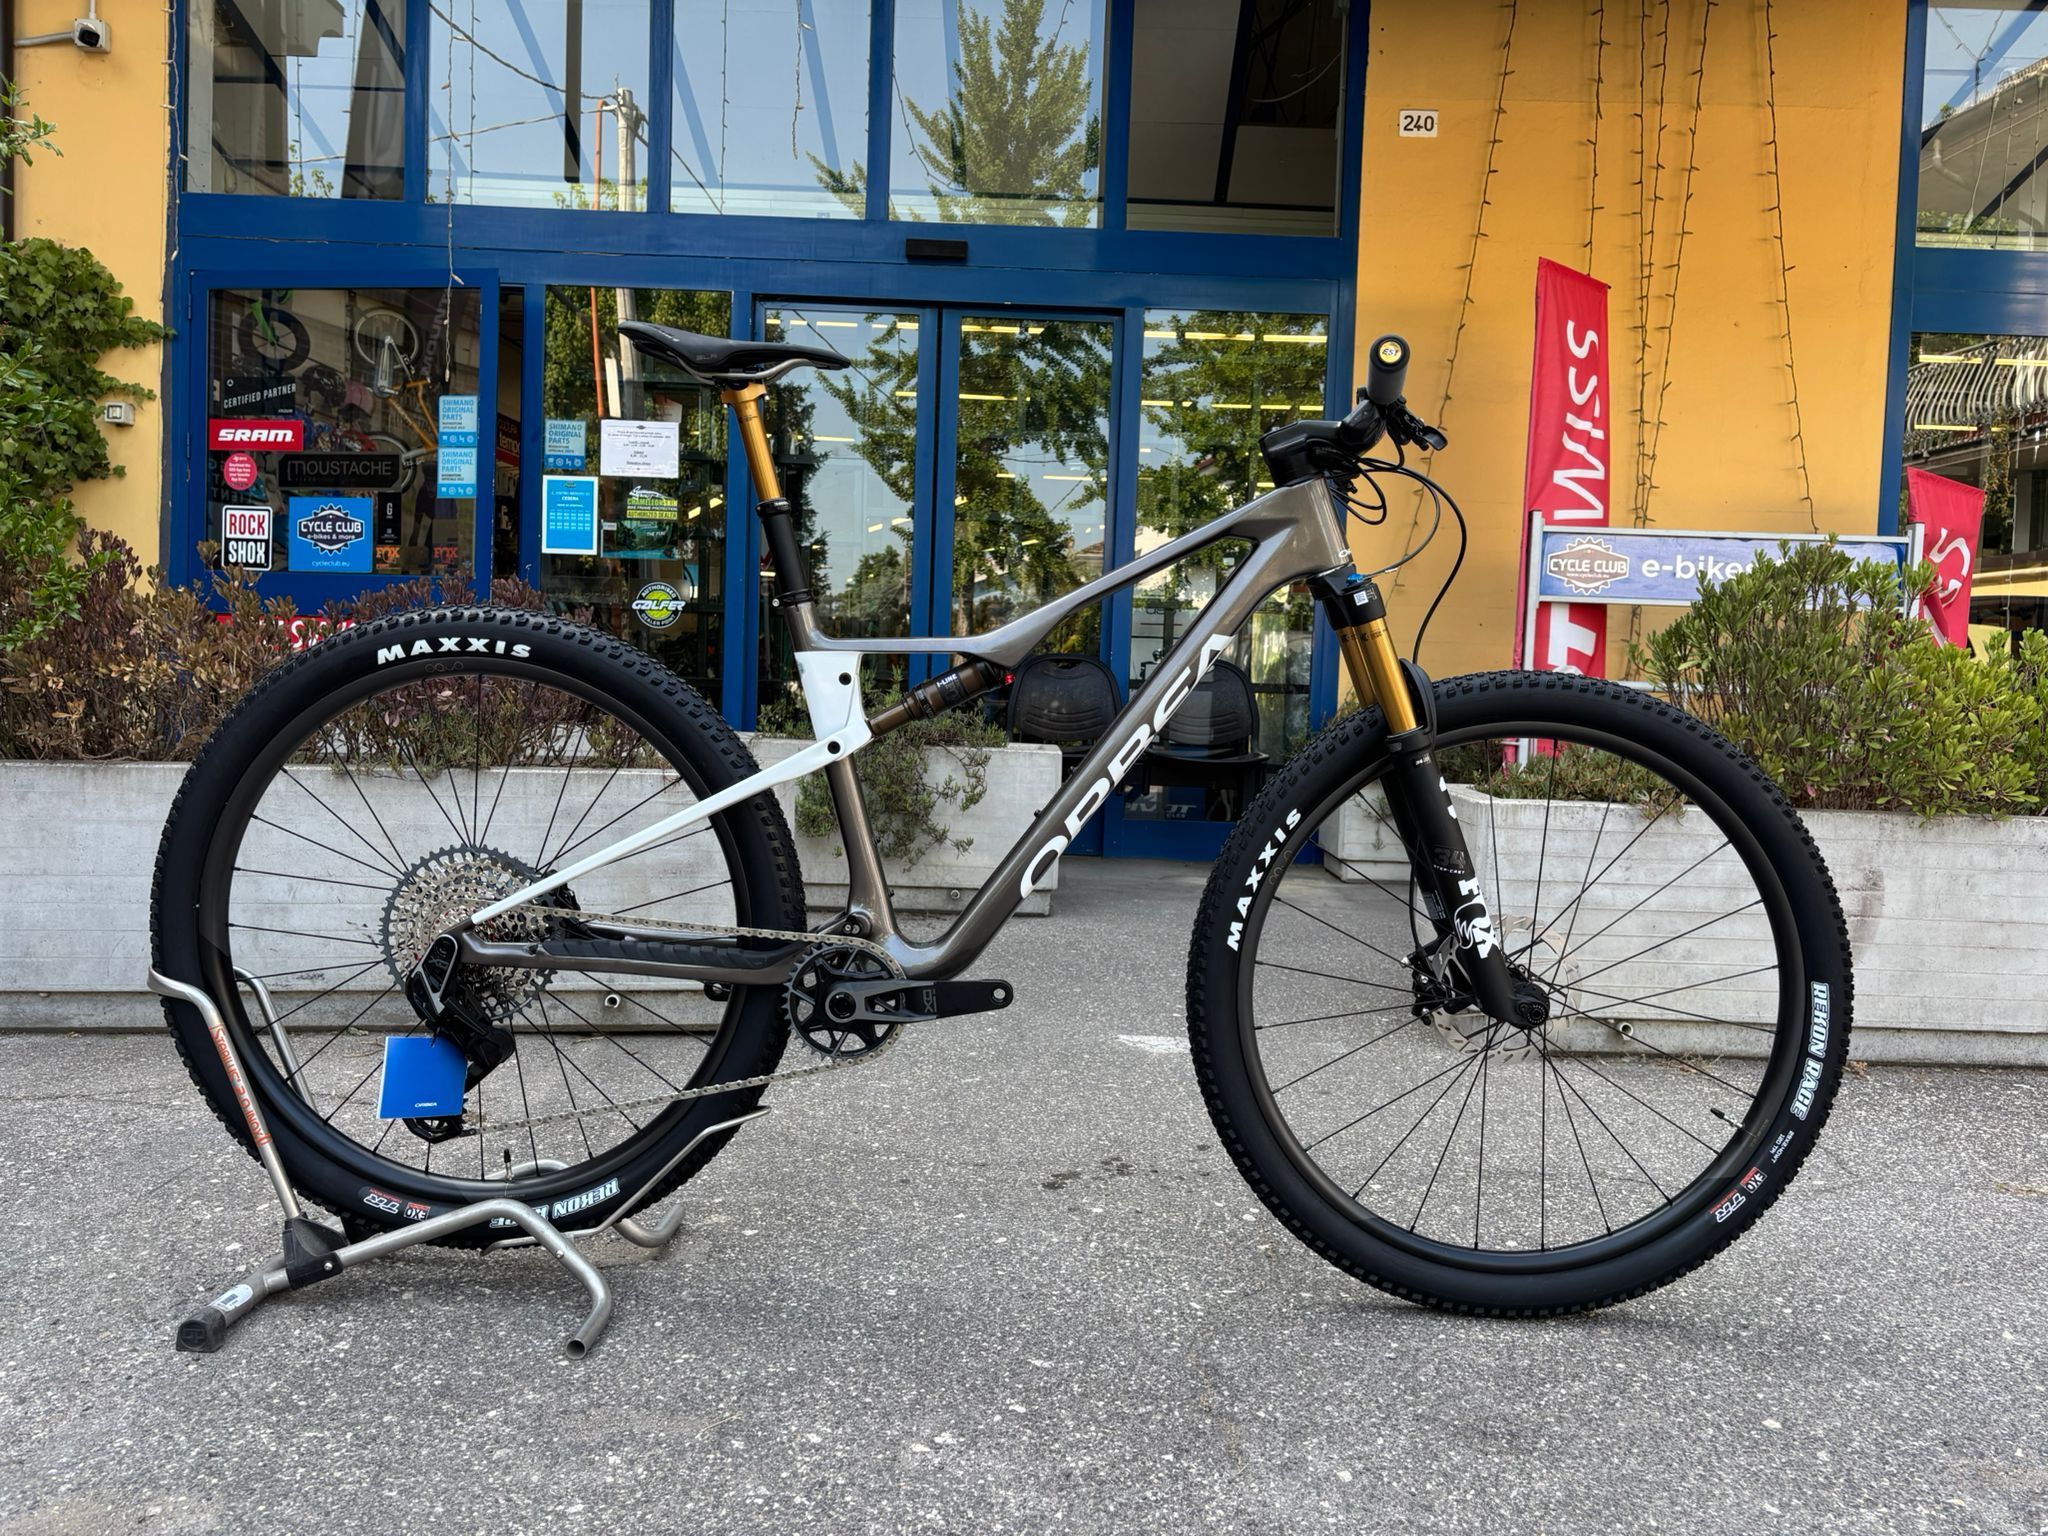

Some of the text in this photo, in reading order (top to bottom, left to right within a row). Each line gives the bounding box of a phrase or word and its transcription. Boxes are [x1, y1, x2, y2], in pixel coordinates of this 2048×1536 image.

[1403, 114, 1434, 132] 240
[223, 383, 297, 409] CERTIFIED PARTNER
[218, 428, 293, 443] SRAM
[548, 430, 582, 438] ORIGINAL
[229, 513, 265, 536] ROCK
[658, 511, 677, 519] DEALER
[300, 521, 362, 533] CYCLE CLUB
[228, 540, 266, 564] SHOX
[376, 547, 400, 561] FOX
[433, 547, 459, 561] FOX
[1550, 558, 1627, 574] CYCLE CLUB
[631, 599, 686, 611] GALFER
[377, 636, 532, 665] MAXXIS
[936, 673, 958, 688] I-LINE
[1227, 808, 1302, 951] MAXXIS
[1454, 877, 1501, 959] FOX
[1790, 981, 1830, 1121] REKON RACE
[1746, 1170, 1766, 1193] EXO
[363, 1193, 400, 1215] TR
[552, 1178, 620, 1219] REKON
[1716, 1192, 1746, 1223] TR
[404, 1206, 429, 1220] EXO
